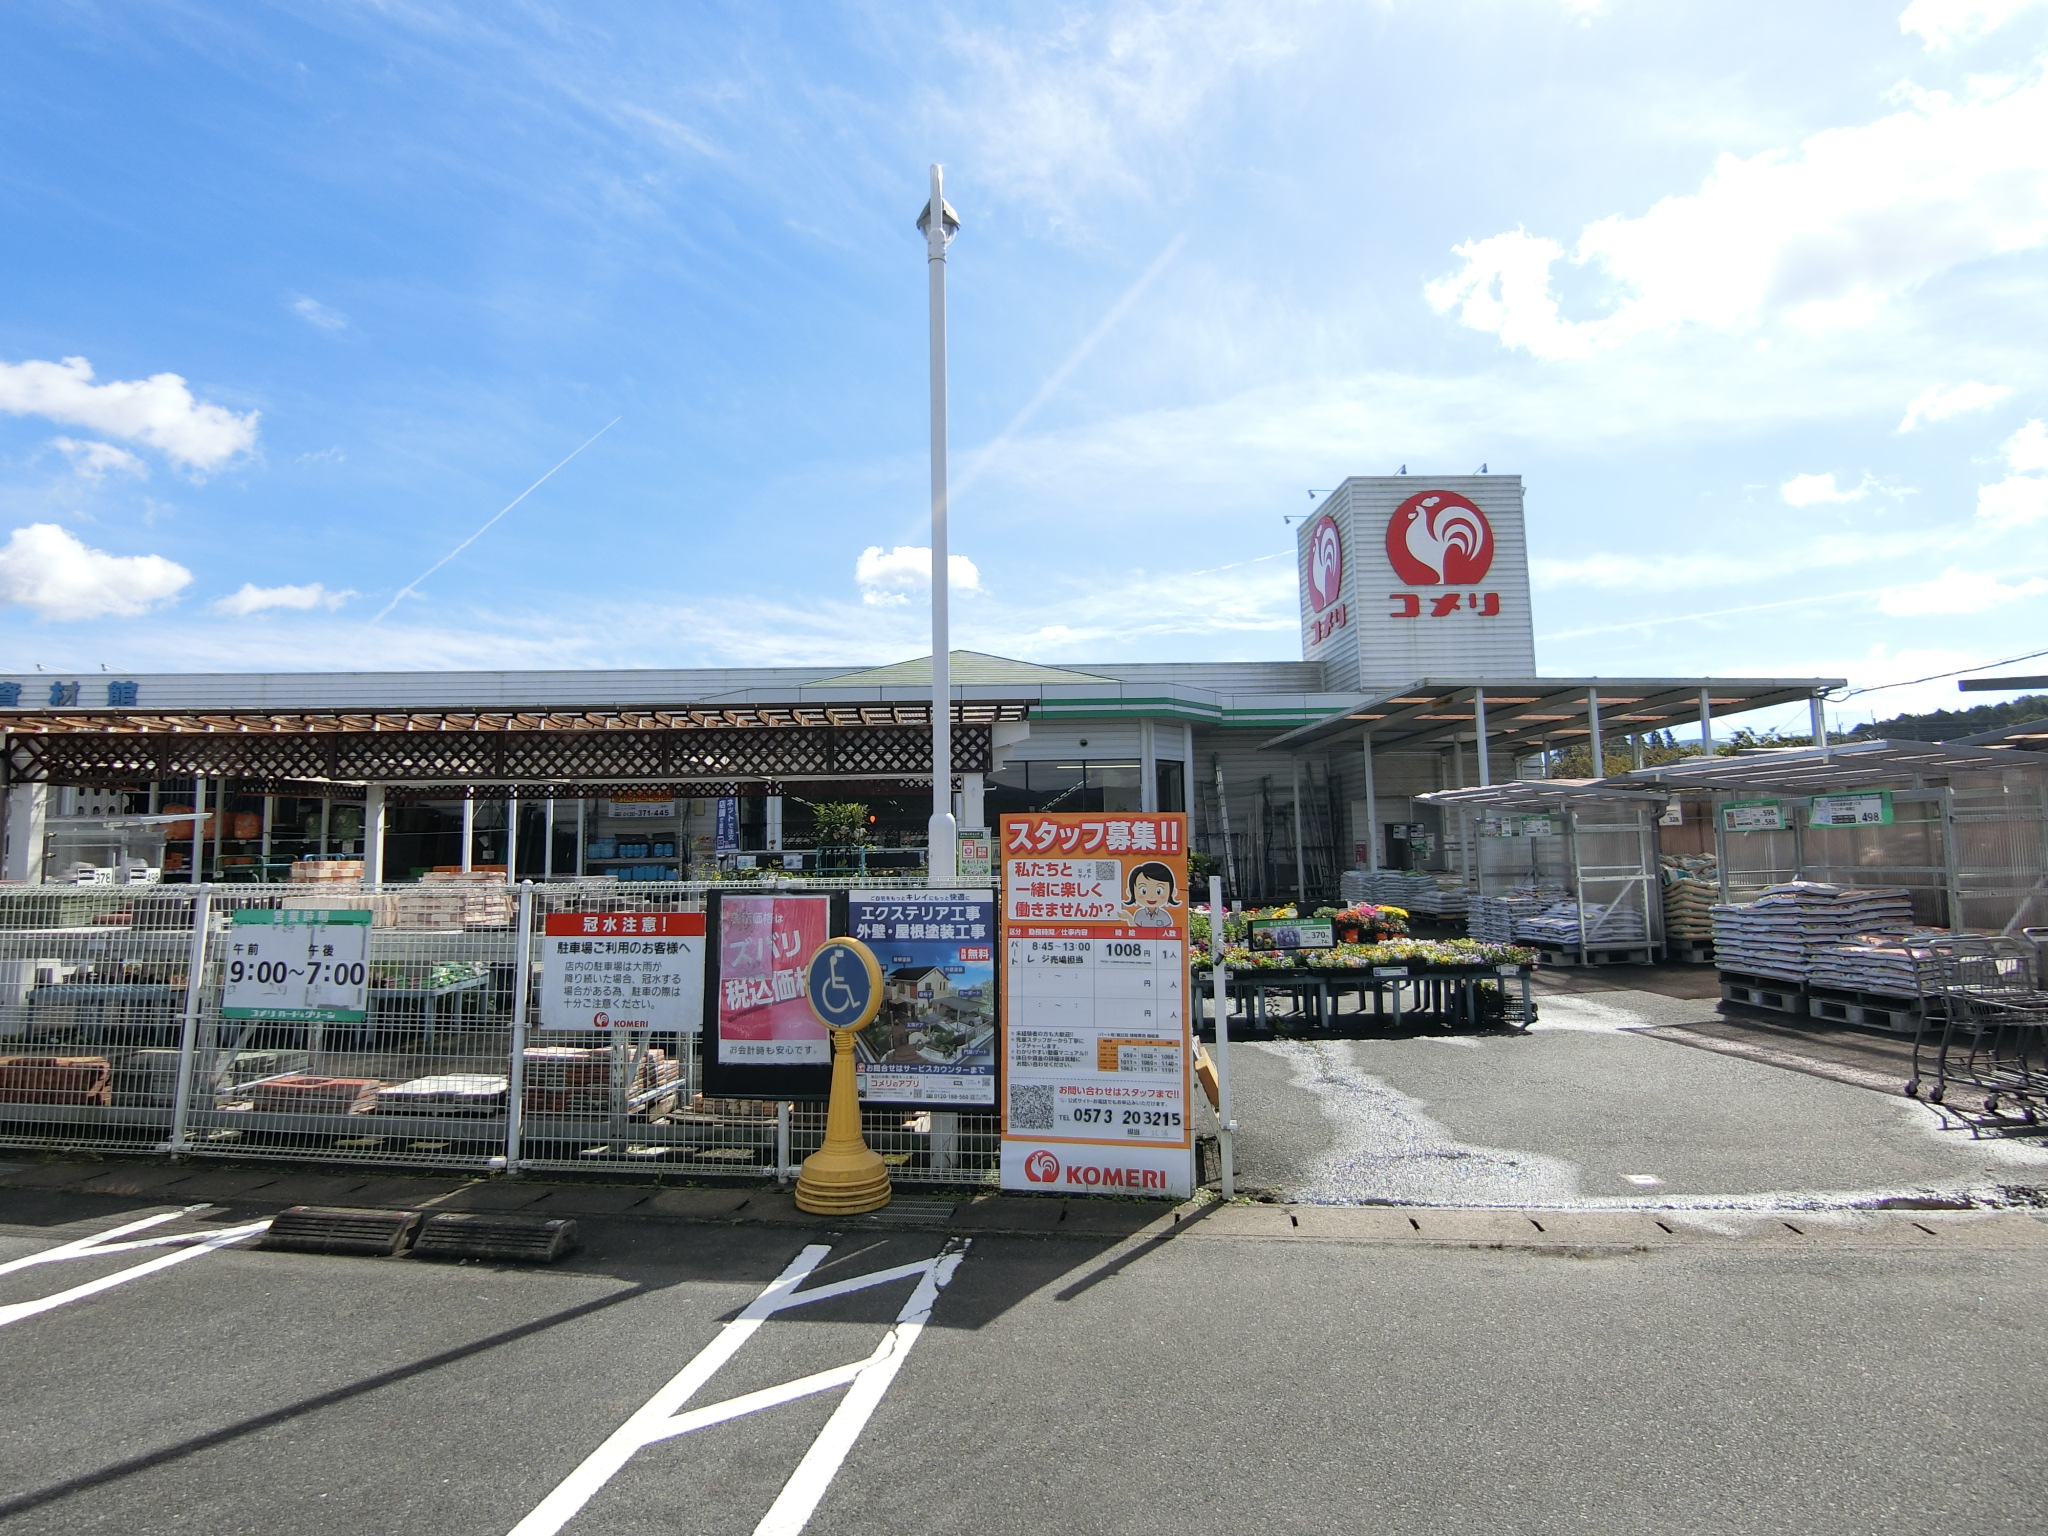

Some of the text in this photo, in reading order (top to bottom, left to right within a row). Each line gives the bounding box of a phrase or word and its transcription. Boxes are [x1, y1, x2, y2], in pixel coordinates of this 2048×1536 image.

[1389, 592, 1500, 618] コメリ
[1310, 603, 1346, 646] コメリ
[1862, 812, 1879, 822] 498
[1008, 820, 1178, 851] スタッフ募集!!
[1015, 862, 1073, 878] 私たちと
[95, 873, 111, 884] 378
[1016, 882, 1103, 898] 一緒に楽しく
[274, 910, 329, 922] 営業時間
[861, 905, 981, 921] エクステリア工事
[1016, 902, 1115, 918] 働きませんか?
[583, 916, 667, 933] 冠水注意！
[857, 923, 986, 939] 外壁・屋根塗装工事
[233, 943, 334, 957] 午前 午後
[557, 941, 691, 955] 駐車場ご利用のお客様へ
[729, 929, 801, 968] ズバリ
[967, 948, 989, 960] 無料
[1011, 940, 1019, 966] パート
[564, 961, 662, 972] 店内の駐車場は大雨が
[564, 973, 681, 984] 降り続いた場合、冠水する
[1170, 981, 1177, 989] 人
[564, 986, 681, 997] 場合がある為、駐車の際は
[563, 999, 656, 1010] 十分ご注意ください。
[1170, 1011, 1177, 1019] 人
[866, 1064, 985, 1074] お問合せはサービスカウンターまで
[871, 1080, 919, 1088] コメリのアプリ
[1058, 1086, 1179, 1099] お問い合わせはスタッフまで!!
[1074, 1108, 1113, 1124] 0573
[1066, 1166, 1166, 1188] KOMERI
